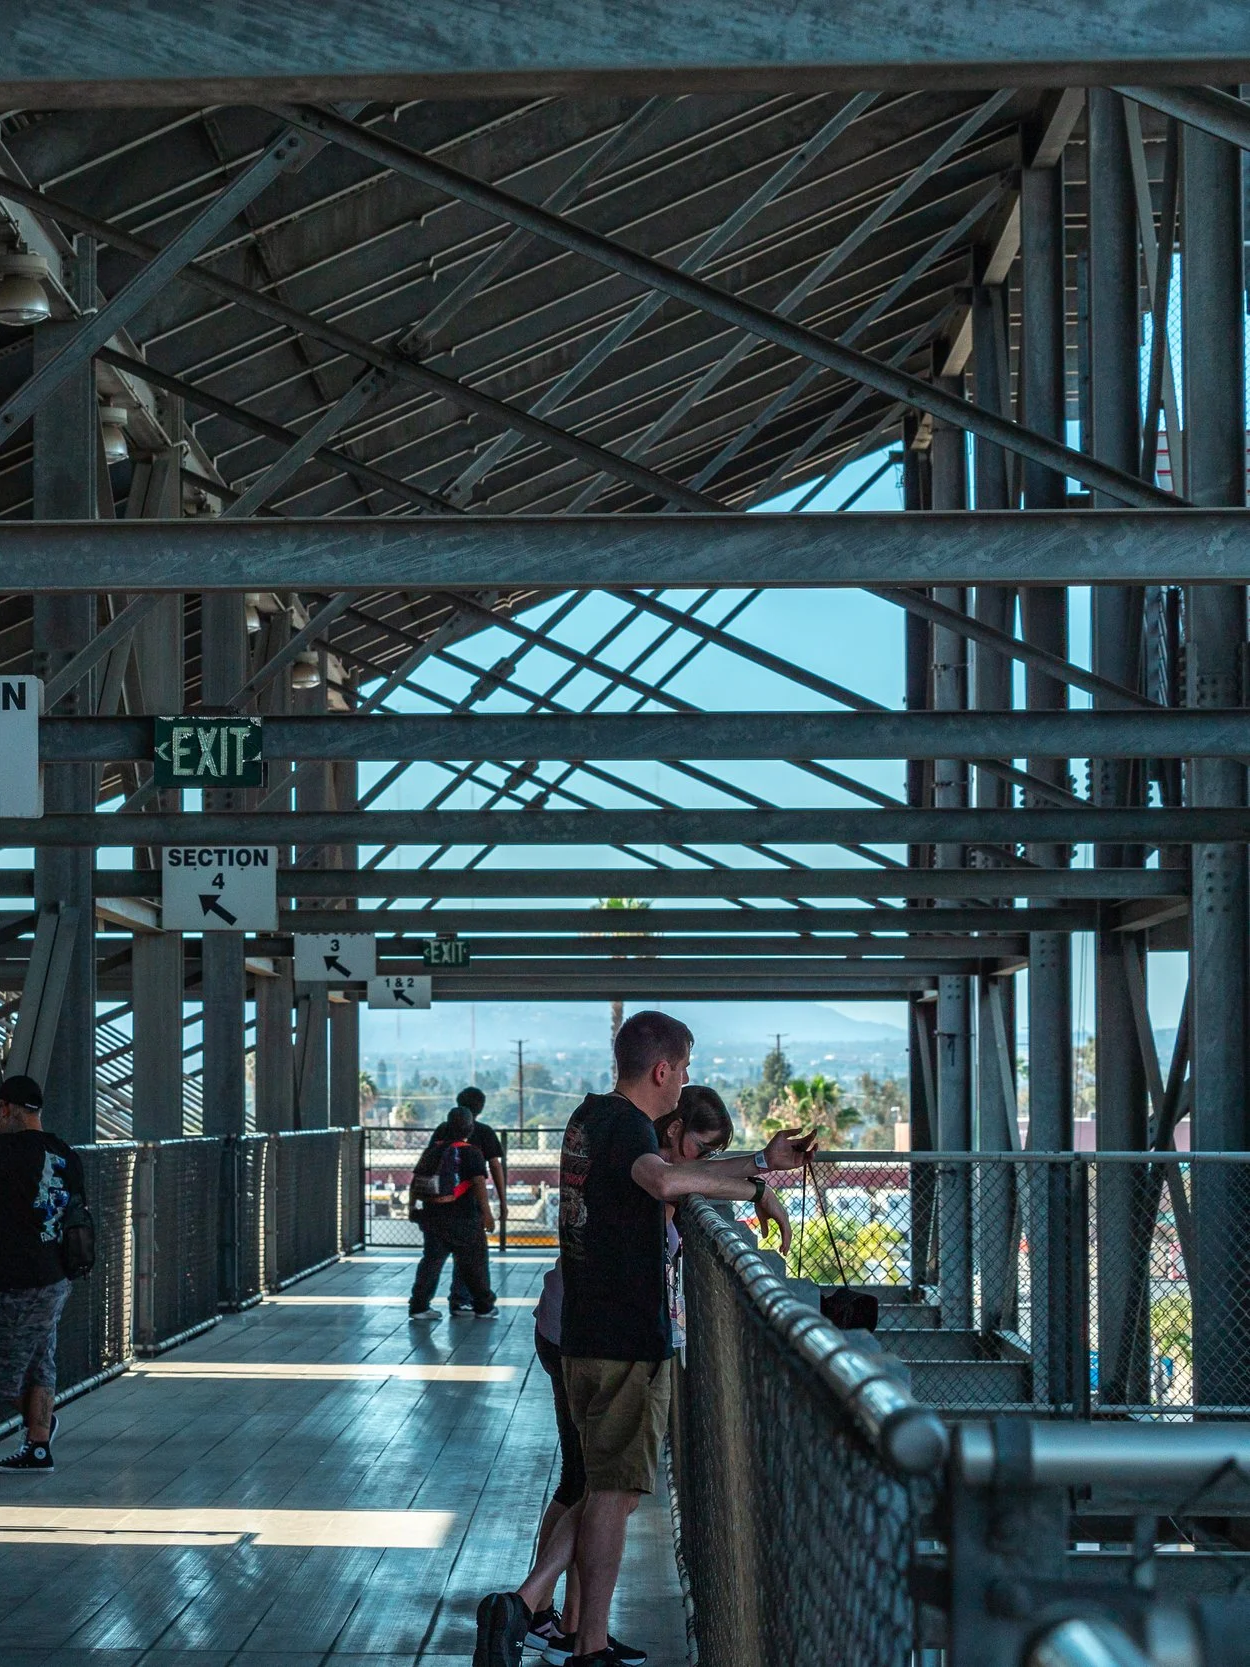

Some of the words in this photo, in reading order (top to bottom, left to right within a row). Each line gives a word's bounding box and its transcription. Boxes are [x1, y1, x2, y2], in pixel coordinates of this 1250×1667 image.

[172, 726, 251, 776] EXIT
[168, 848, 269, 867] SECTION
[211, 872, 225, 890] 4
[330, 939, 340, 952] 3
[430, 941, 466, 964] EXIT
[385, 978, 390, 988] 1
[395, 977, 403, 988] &
[407, 978, 415, 988] 2
